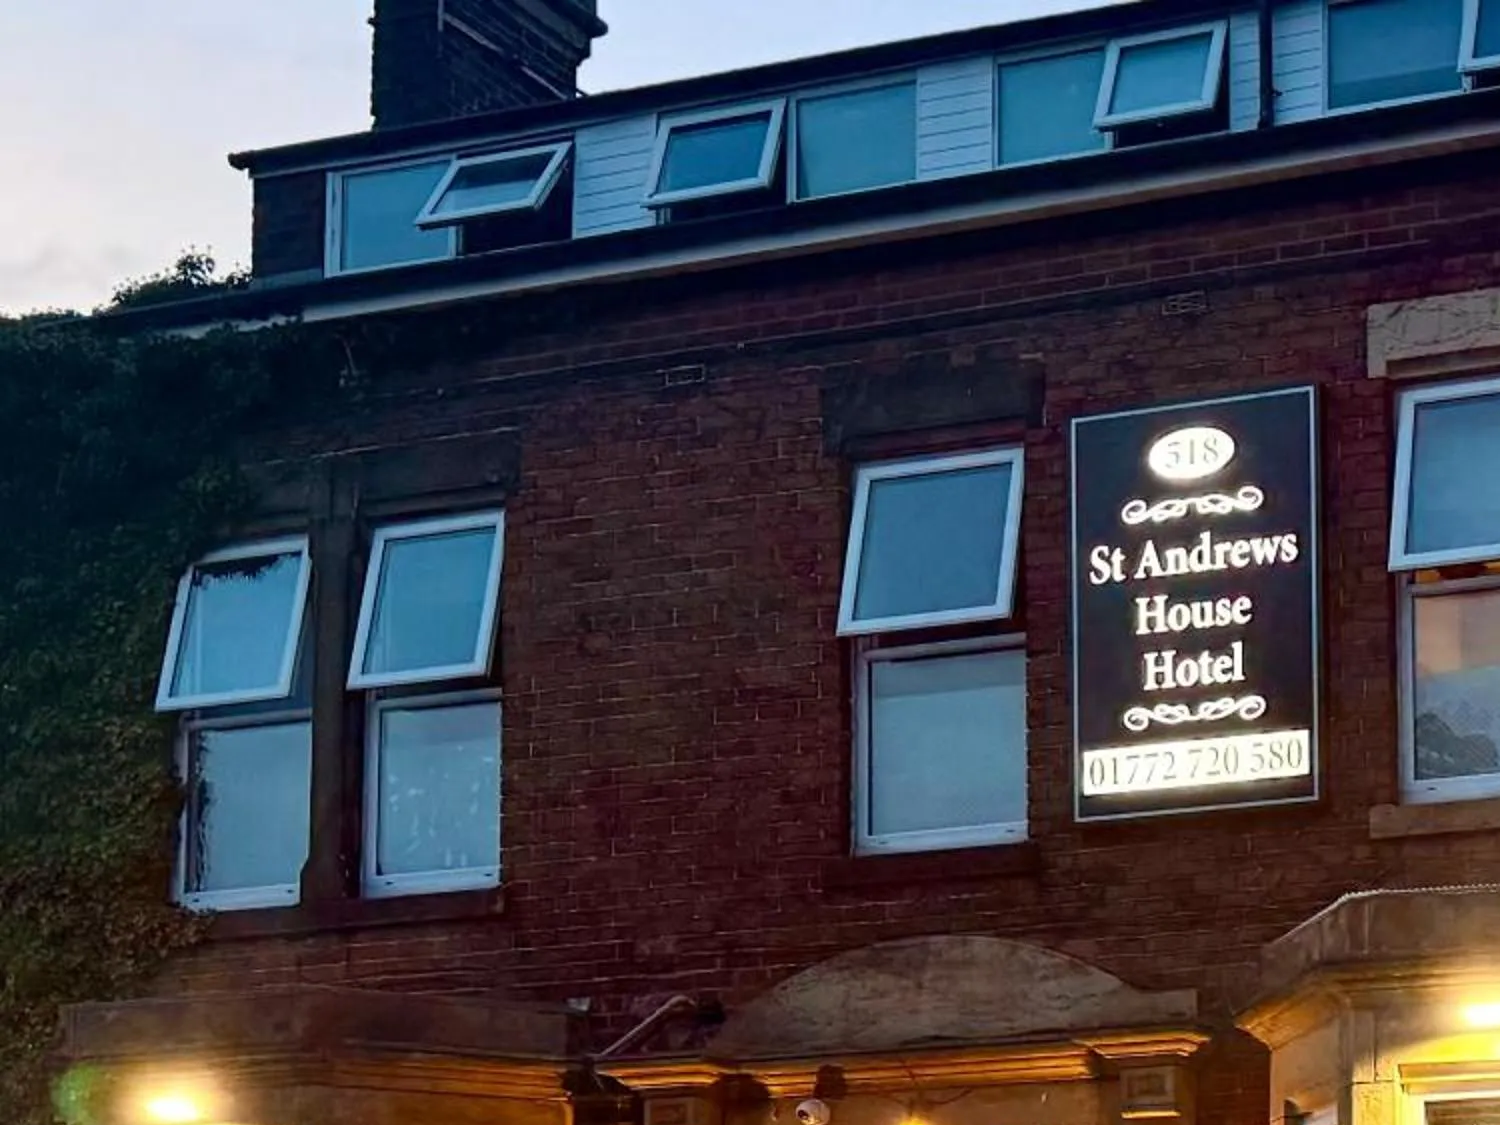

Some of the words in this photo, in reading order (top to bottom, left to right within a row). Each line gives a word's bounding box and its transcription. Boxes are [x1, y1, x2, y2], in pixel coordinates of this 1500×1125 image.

[1164, 434, 1219, 469] 518
[1089, 545, 1126, 585] St
[1135, 532, 1299, 579] Andrews
[1135, 594, 1253, 635] House
[1143, 642, 1246, 691] Hotel
[1089, 751, 1177, 788] 01772
[1188, 744, 1240, 780] 720
[1249, 738, 1303, 773] 580
